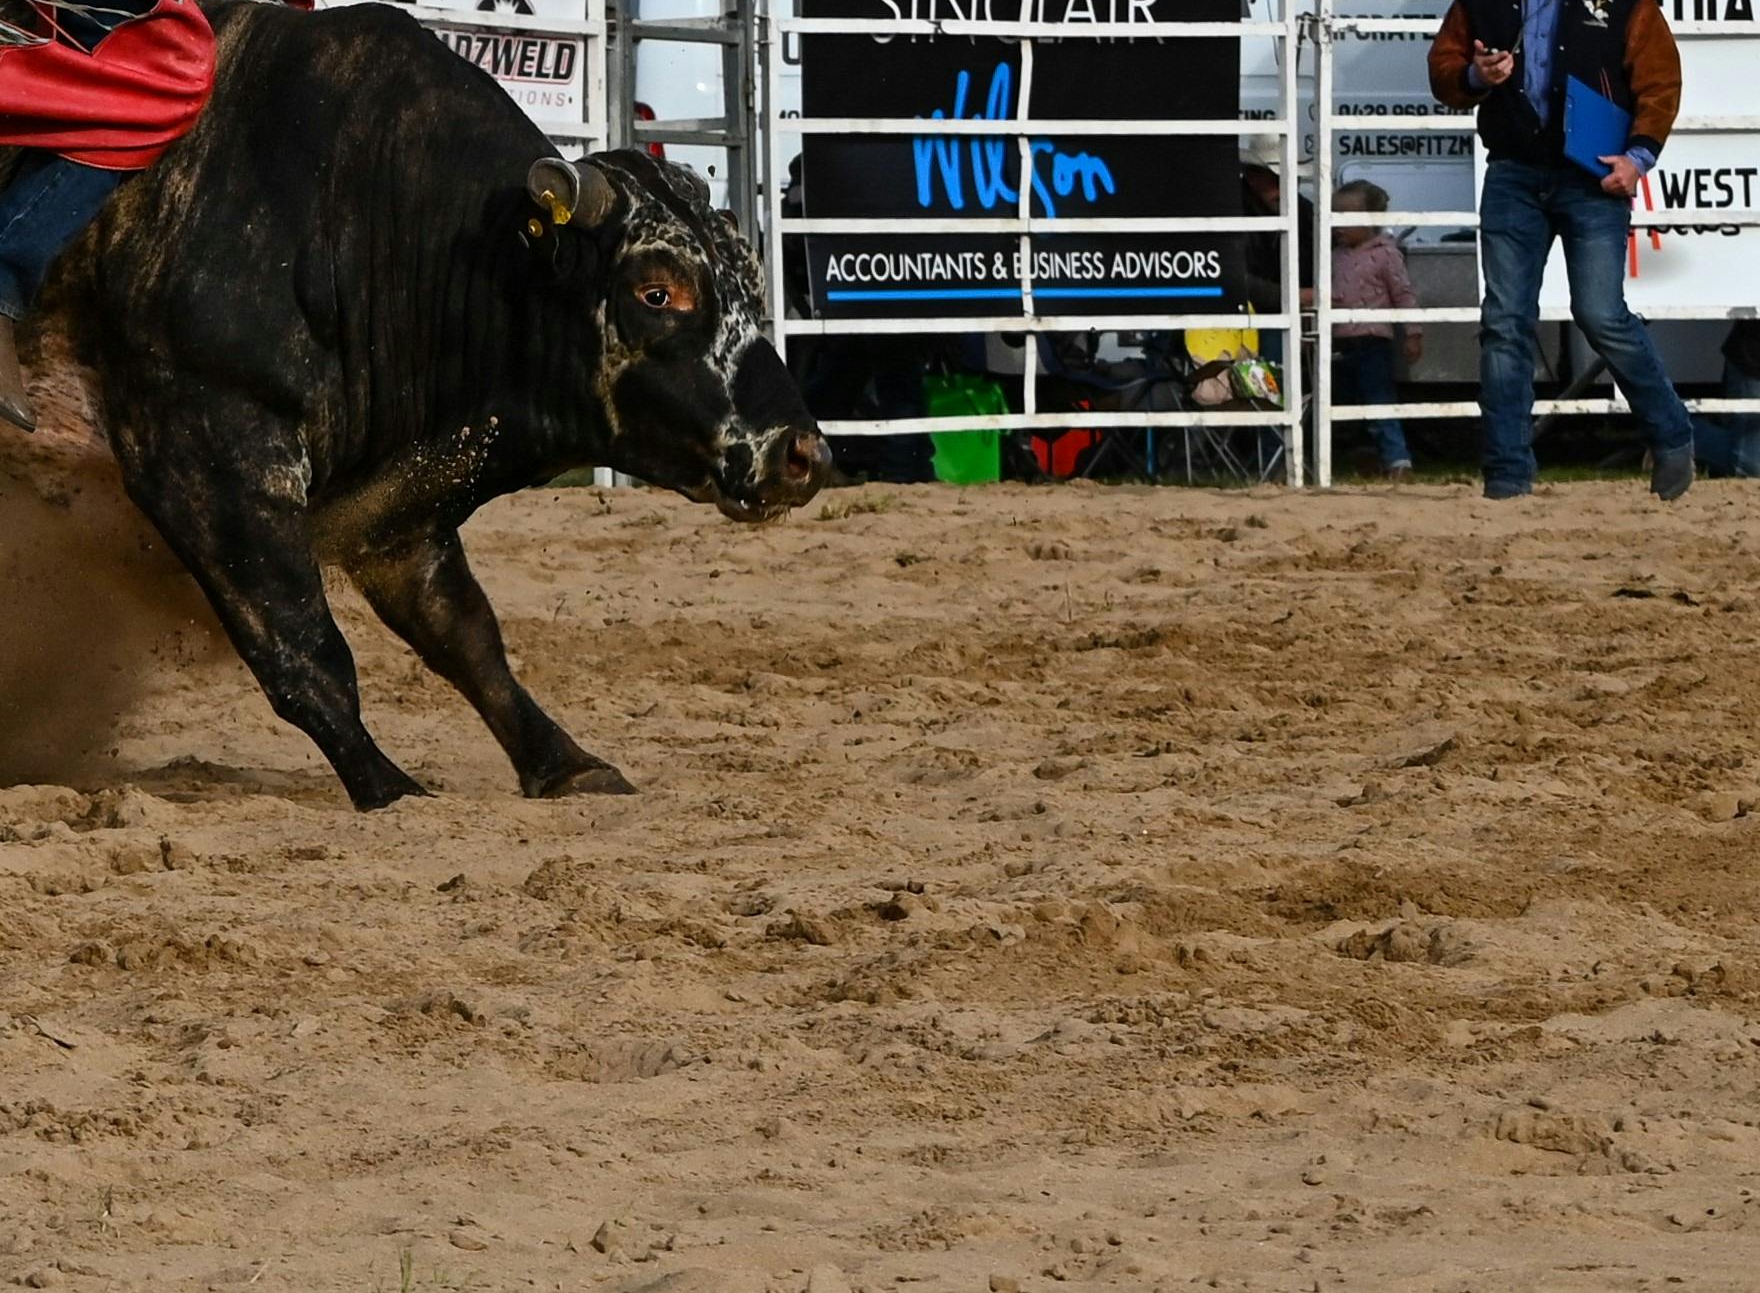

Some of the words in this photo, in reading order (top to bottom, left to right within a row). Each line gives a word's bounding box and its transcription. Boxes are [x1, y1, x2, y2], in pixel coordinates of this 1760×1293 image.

[1659, 168, 1758, 209] WEST
[826, 251, 986, 283] ACCOUNTANTS
[992, 254, 1008, 280] &
[1110, 250, 1221, 279] ADVISORS
